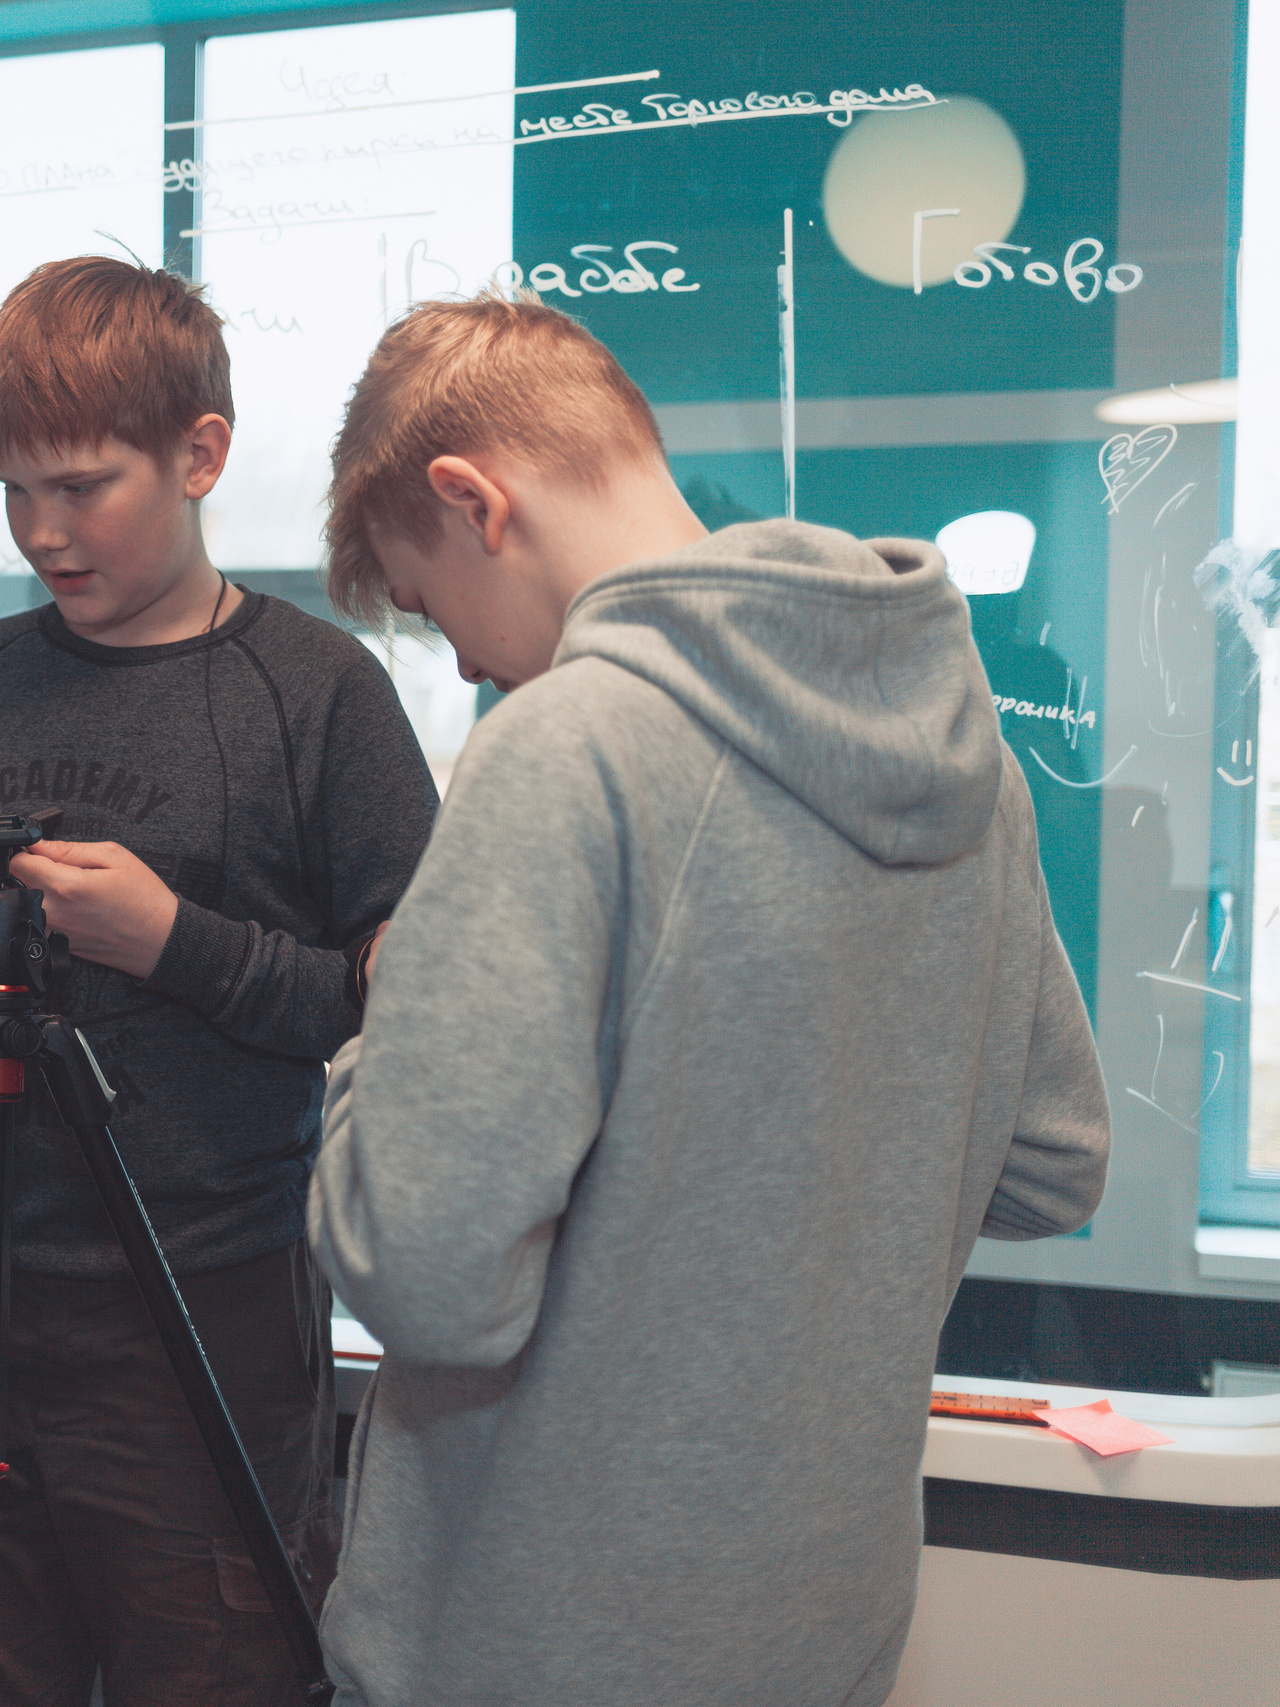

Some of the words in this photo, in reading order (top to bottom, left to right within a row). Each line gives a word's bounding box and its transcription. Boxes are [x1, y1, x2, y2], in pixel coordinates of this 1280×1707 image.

[519, 103, 633, 136] месте
[827, 83, 937, 128] дома
[913, 208, 1144, 303] Готово
